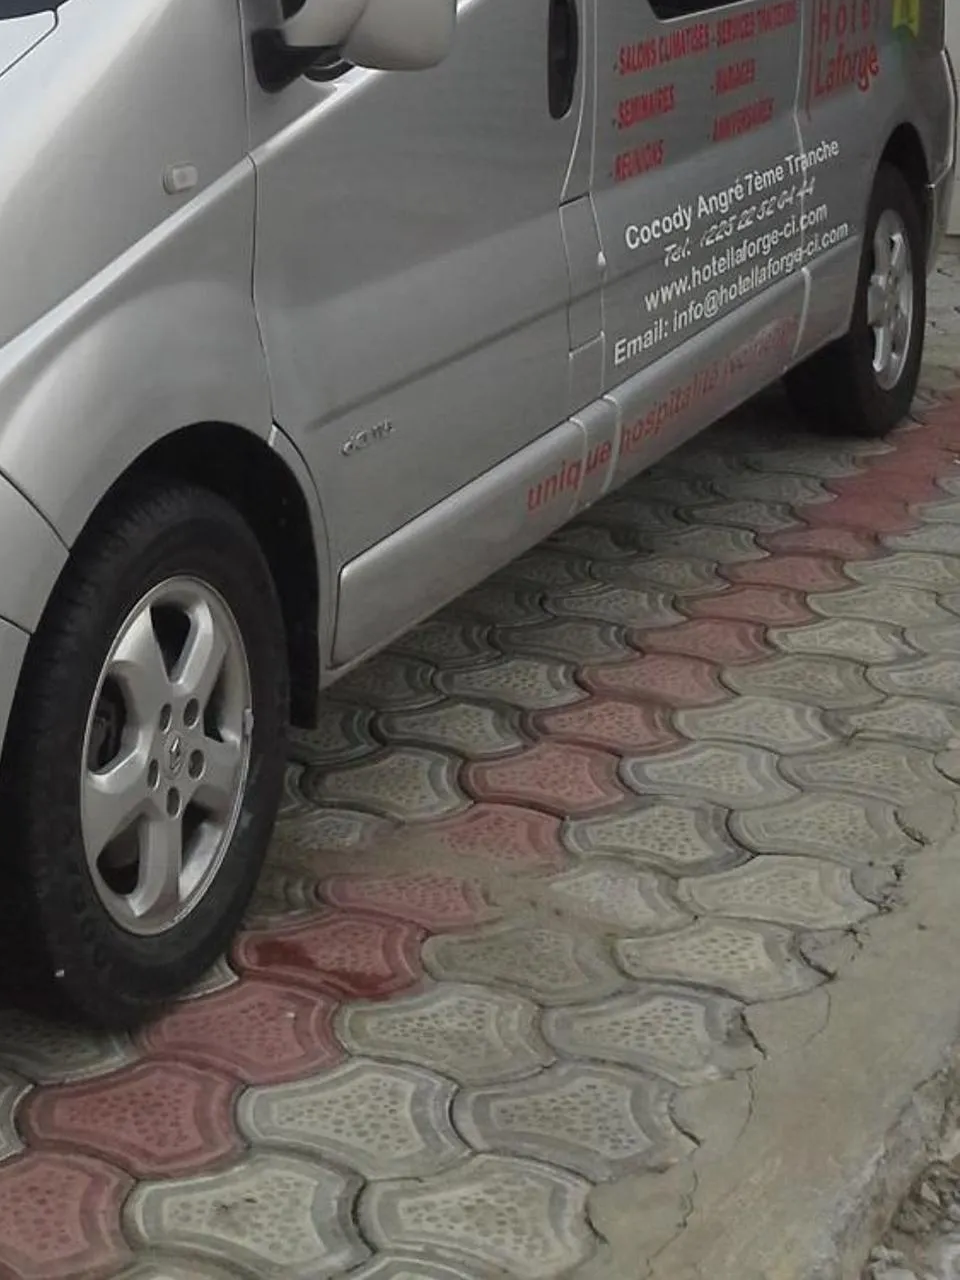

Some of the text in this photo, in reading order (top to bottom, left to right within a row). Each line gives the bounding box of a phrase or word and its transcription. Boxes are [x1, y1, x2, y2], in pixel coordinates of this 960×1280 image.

[625, 140, 839, 250] Cocody Angré 7ème Tranche
[614, 318, 669, 366] Email:
[673, 222, 849, 334] info@hotellaforge-ci.com
[644, 203, 827, 313] www.hotellaforge-ci.com
[526, 439, 611, 511] unique
